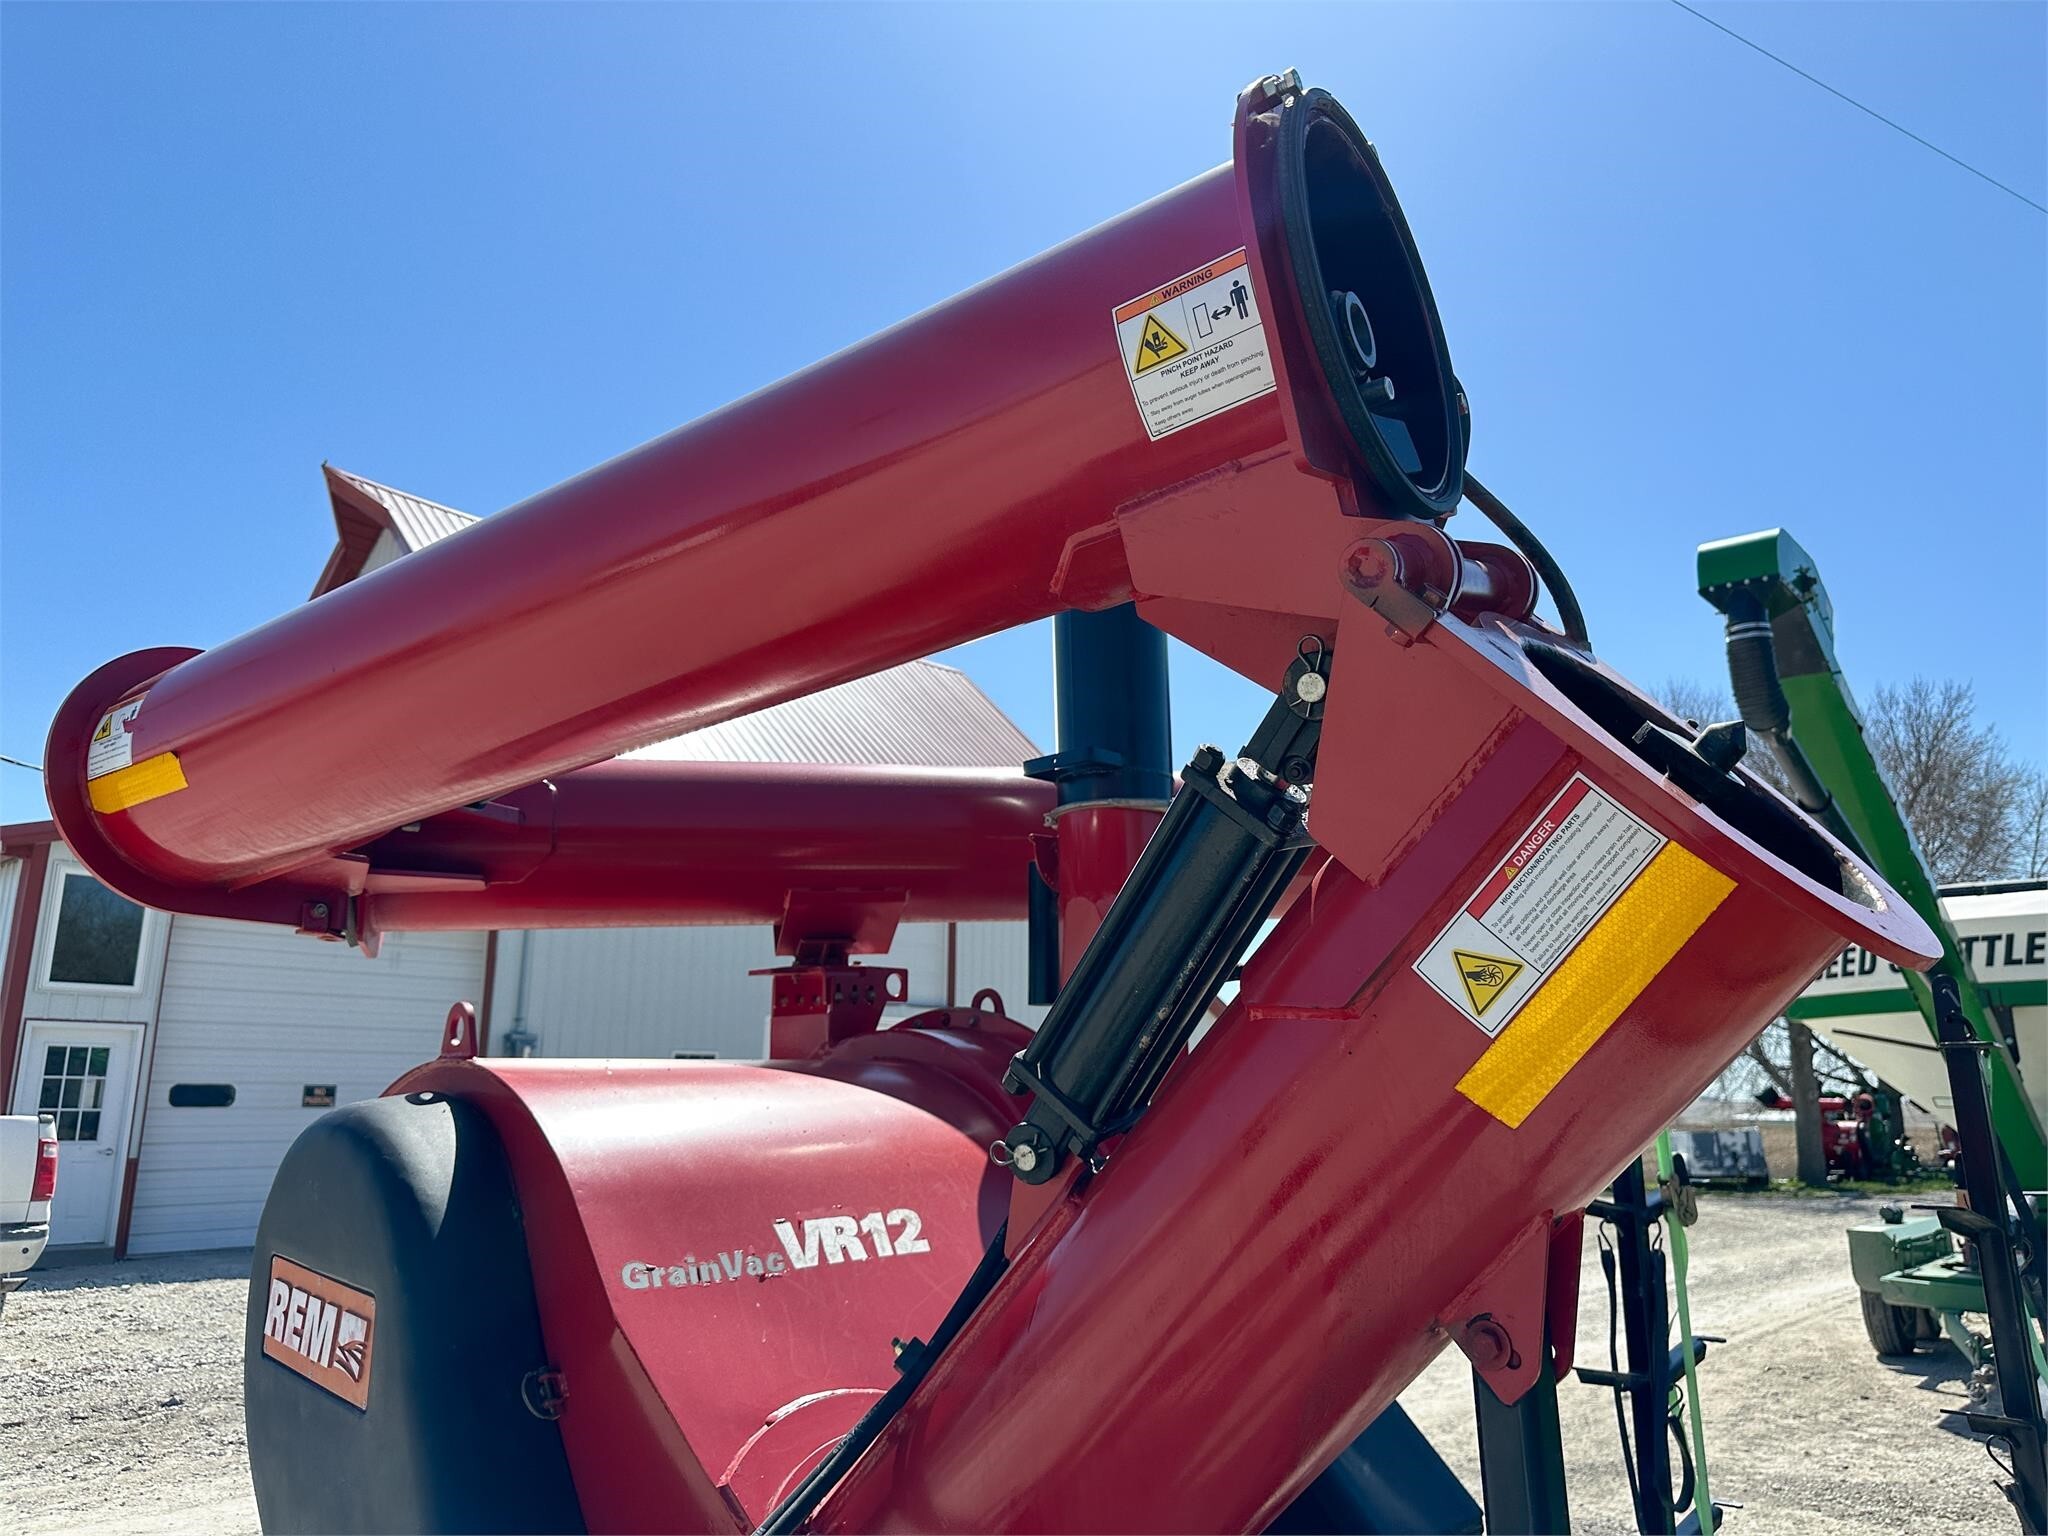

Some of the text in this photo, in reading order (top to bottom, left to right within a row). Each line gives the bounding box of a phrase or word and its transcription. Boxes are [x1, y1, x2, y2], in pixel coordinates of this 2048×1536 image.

[1162, 269, 1213, 299] WARNING
[1149, 392, 1169, 405] prevent
[1169, 384, 1188, 395] serious
[1189, 377, 1203, 386] injury
[1211, 367, 1226, 377] death
[1227, 361, 1240, 369] from
[1160, 340, 1233, 377] PINCH POINT HAZARD
[1180, 356, 1219, 378] KEEP AWAY
[1225, 366, 1261, 384] opening/closing
[1497, 905, 1513, 923] prevent
[1511, 893, 1524, 906] being
[1522, 879, 1536, 895] pulled
[1533, 853, 1558, 880] involuntarily
[1556, 845, 1565, 854] into
[1564, 827, 1581, 845] rotating
[1578, 811, 1593, 828] blower
[1500, 813, 1580, 905] HIGH SUCTION/ROTATING PARTS
[1509, 812, 1618, 936] Keep clothing and yourself well clear and others away from
[1513, 820, 1555, 866] DANGER
[1523, 934, 1536, 948] Never
[1536, 923, 1547, 934] open
[1550, 905, 1562, 918] close
[1561, 883, 1582, 905] inspection
[1581, 870, 1594, 883] doors
[1592, 855, 1607, 870] unless
[1606, 842, 1617, 855] grain
[1616, 833, 1625, 842] vac
[1623, 824, 1635, 834] has
[1529, 941, 1541, 953] been
[1540, 930, 1550, 942] shut
[1554, 915, 1563, 925] and
[1567, 893, 1584, 910] moving
[1582, 882, 1593, 895] parts
[1591, 870, 1603, 882] have
[1602, 851, 1620, 870] stopped
[1618, 827, 1641, 852] completely
[1534, 948, 1549, 964] Failure
[1552, 931, 1564, 944] heed
[1562, 923, 1571, 932] this
[1570, 905, 1588, 923] warning
[1586, 895, 1596, 906] may
[1595, 881, 1608, 896] result
[1611, 860, 1627, 877] serious
[1816, 946, 1876, 980] EED
[621, 1208, 931, 1290] GrainVac VR12
[264, 1279, 338, 1368] REM
